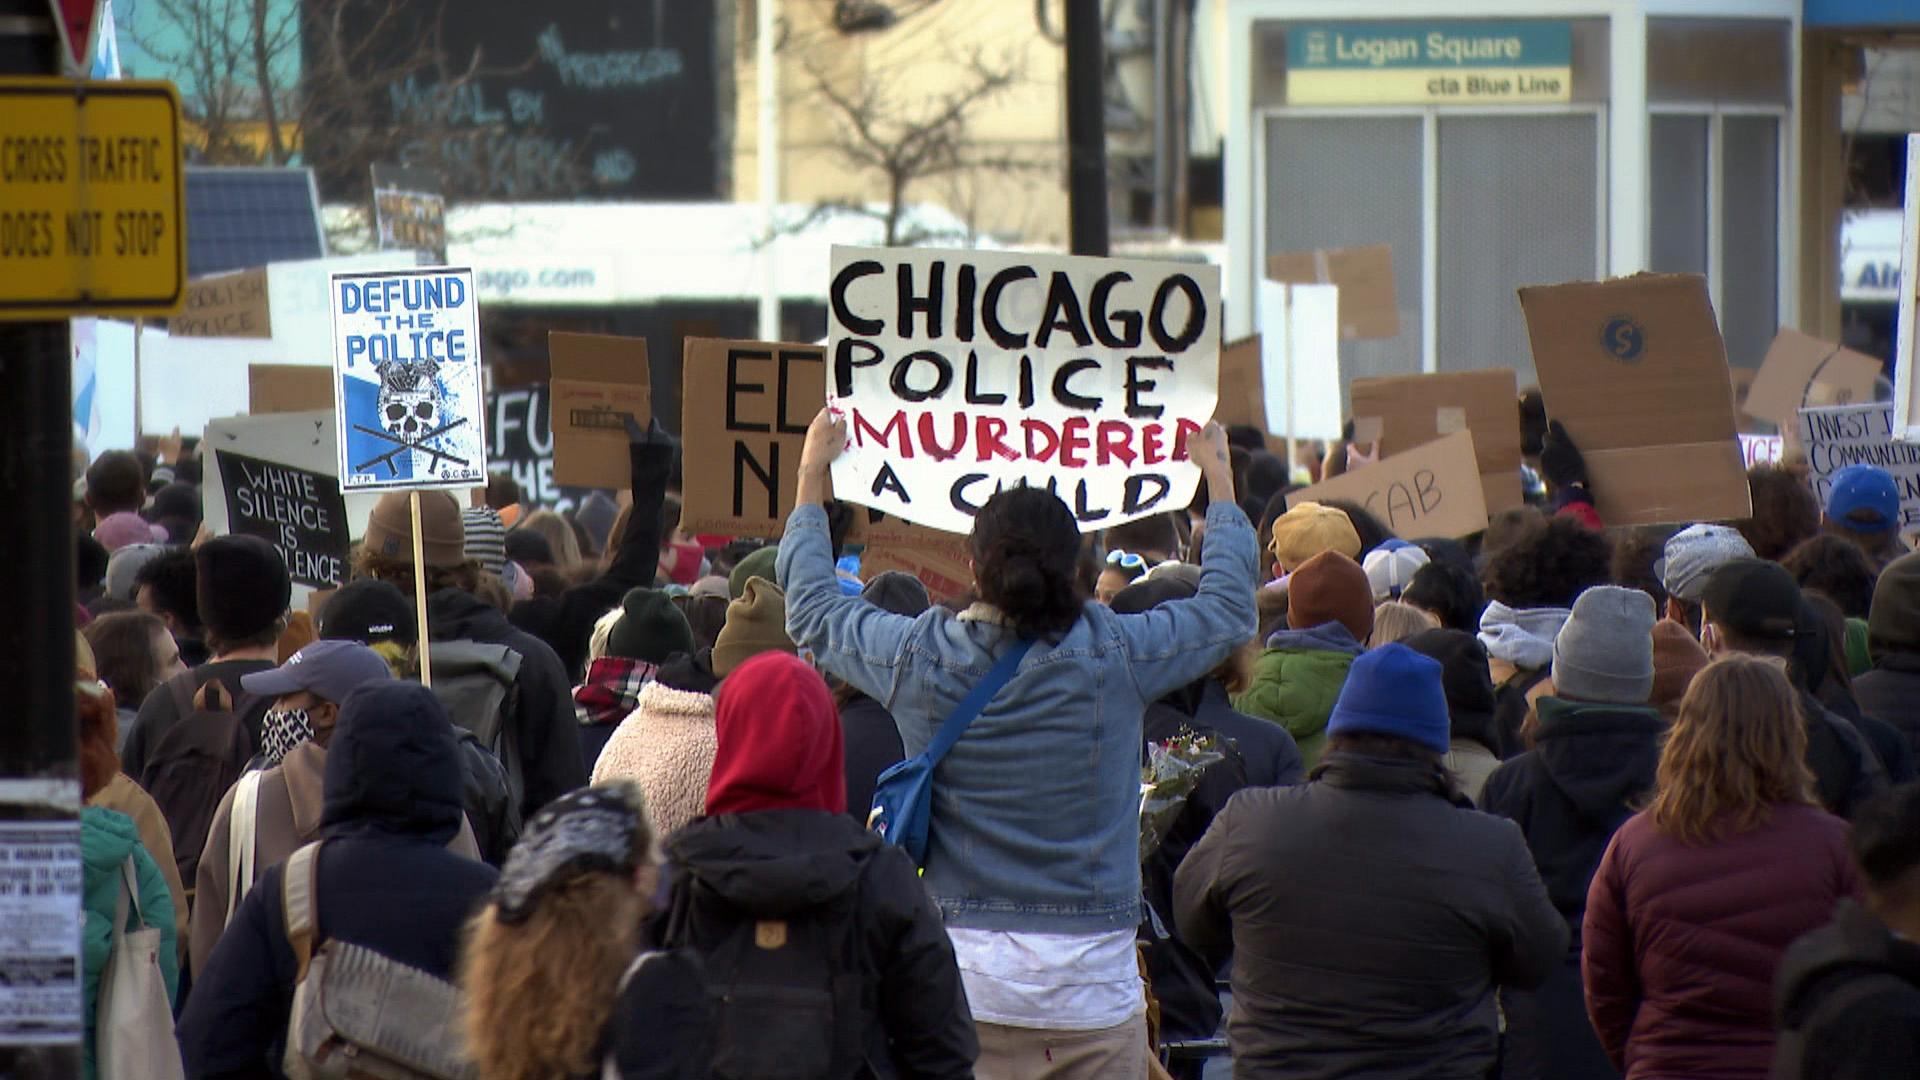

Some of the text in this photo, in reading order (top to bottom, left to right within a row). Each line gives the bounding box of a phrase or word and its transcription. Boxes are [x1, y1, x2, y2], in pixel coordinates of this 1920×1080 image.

[1336, 32, 1521, 65] Logan Square
[1427, 75, 1561, 95] cta Blue Line
[2, 137, 161, 183] CROSS TRAFFIC
[1, 211, 165, 257] DOES NOT STOP
[187, 280, 264, 309] BOLISH
[341, 277, 465, 315] DEFUND
[478, 270, 596, 294] ago.com
[375, 313, 434, 331] THE
[831, 261, 1208, 353] CHICAGO
[347, 329, 466, 368] POLICE
[834, 338, 1174, 419] POLICE
[1804, 411, 1872, 443] INVEST
[240, 461, 320, 502] WHITE
[872, 461, 911, 503] A
[236, 487, 331, 533] SILENCE
[279, 523, 298, 549] IS
